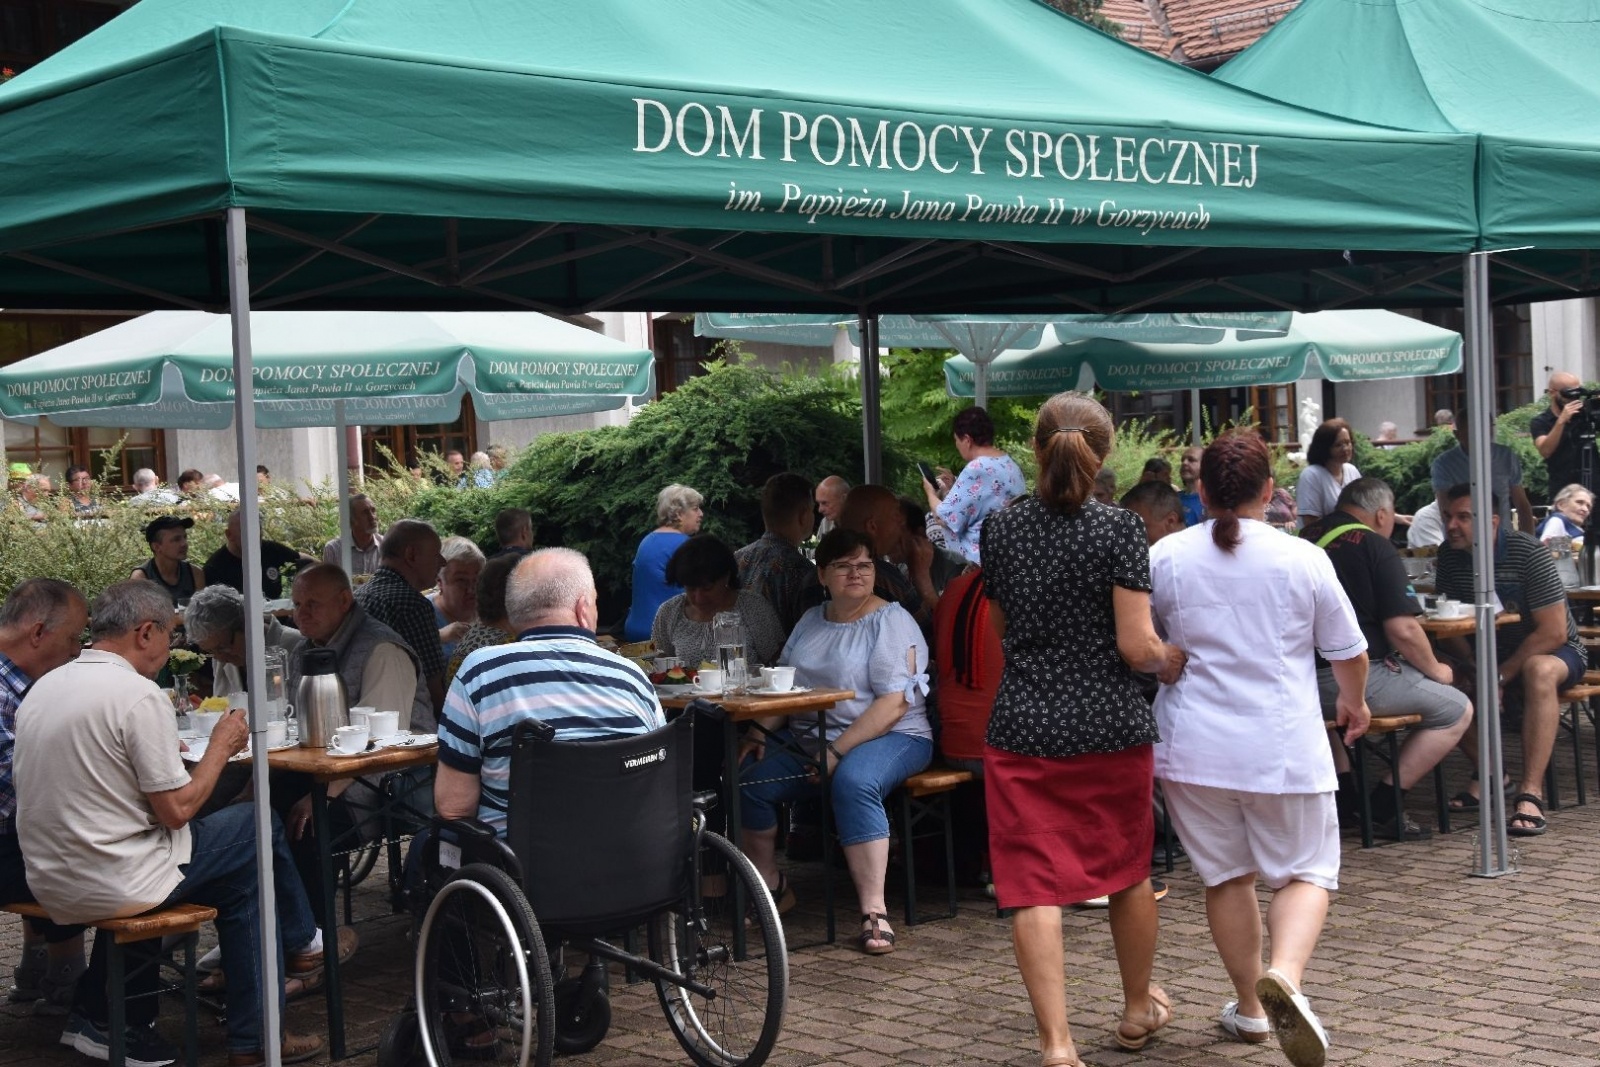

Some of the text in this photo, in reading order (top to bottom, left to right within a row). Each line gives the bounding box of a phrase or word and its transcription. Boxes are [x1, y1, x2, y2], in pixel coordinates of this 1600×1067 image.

[632, 98, 1260, 188] DOM POMOCY SPOŁECZNEJ
[724, 181, 1211, 236] im. Papieża Jana Pawła II w Gorzycach
[330, 361, 440, 379] SPOŁECZNEJ
[490, 361, 640, 377] DOM POMOCY SPOŁECZNEJ
[1108, 356, 1290, 376] DOM POMOCY SPOŁECZNEJ
[8, 380, 31, 397] DOM
[33, 376, 80, 395] POMOCY
[253, 386, 284, 398] apieża
[285, 384, 309, 394] Jana
[311, 383, 342, 394] Pawła
[355, 384, 363, 392] w
[366, 381, 416, 394] Gorzycach
